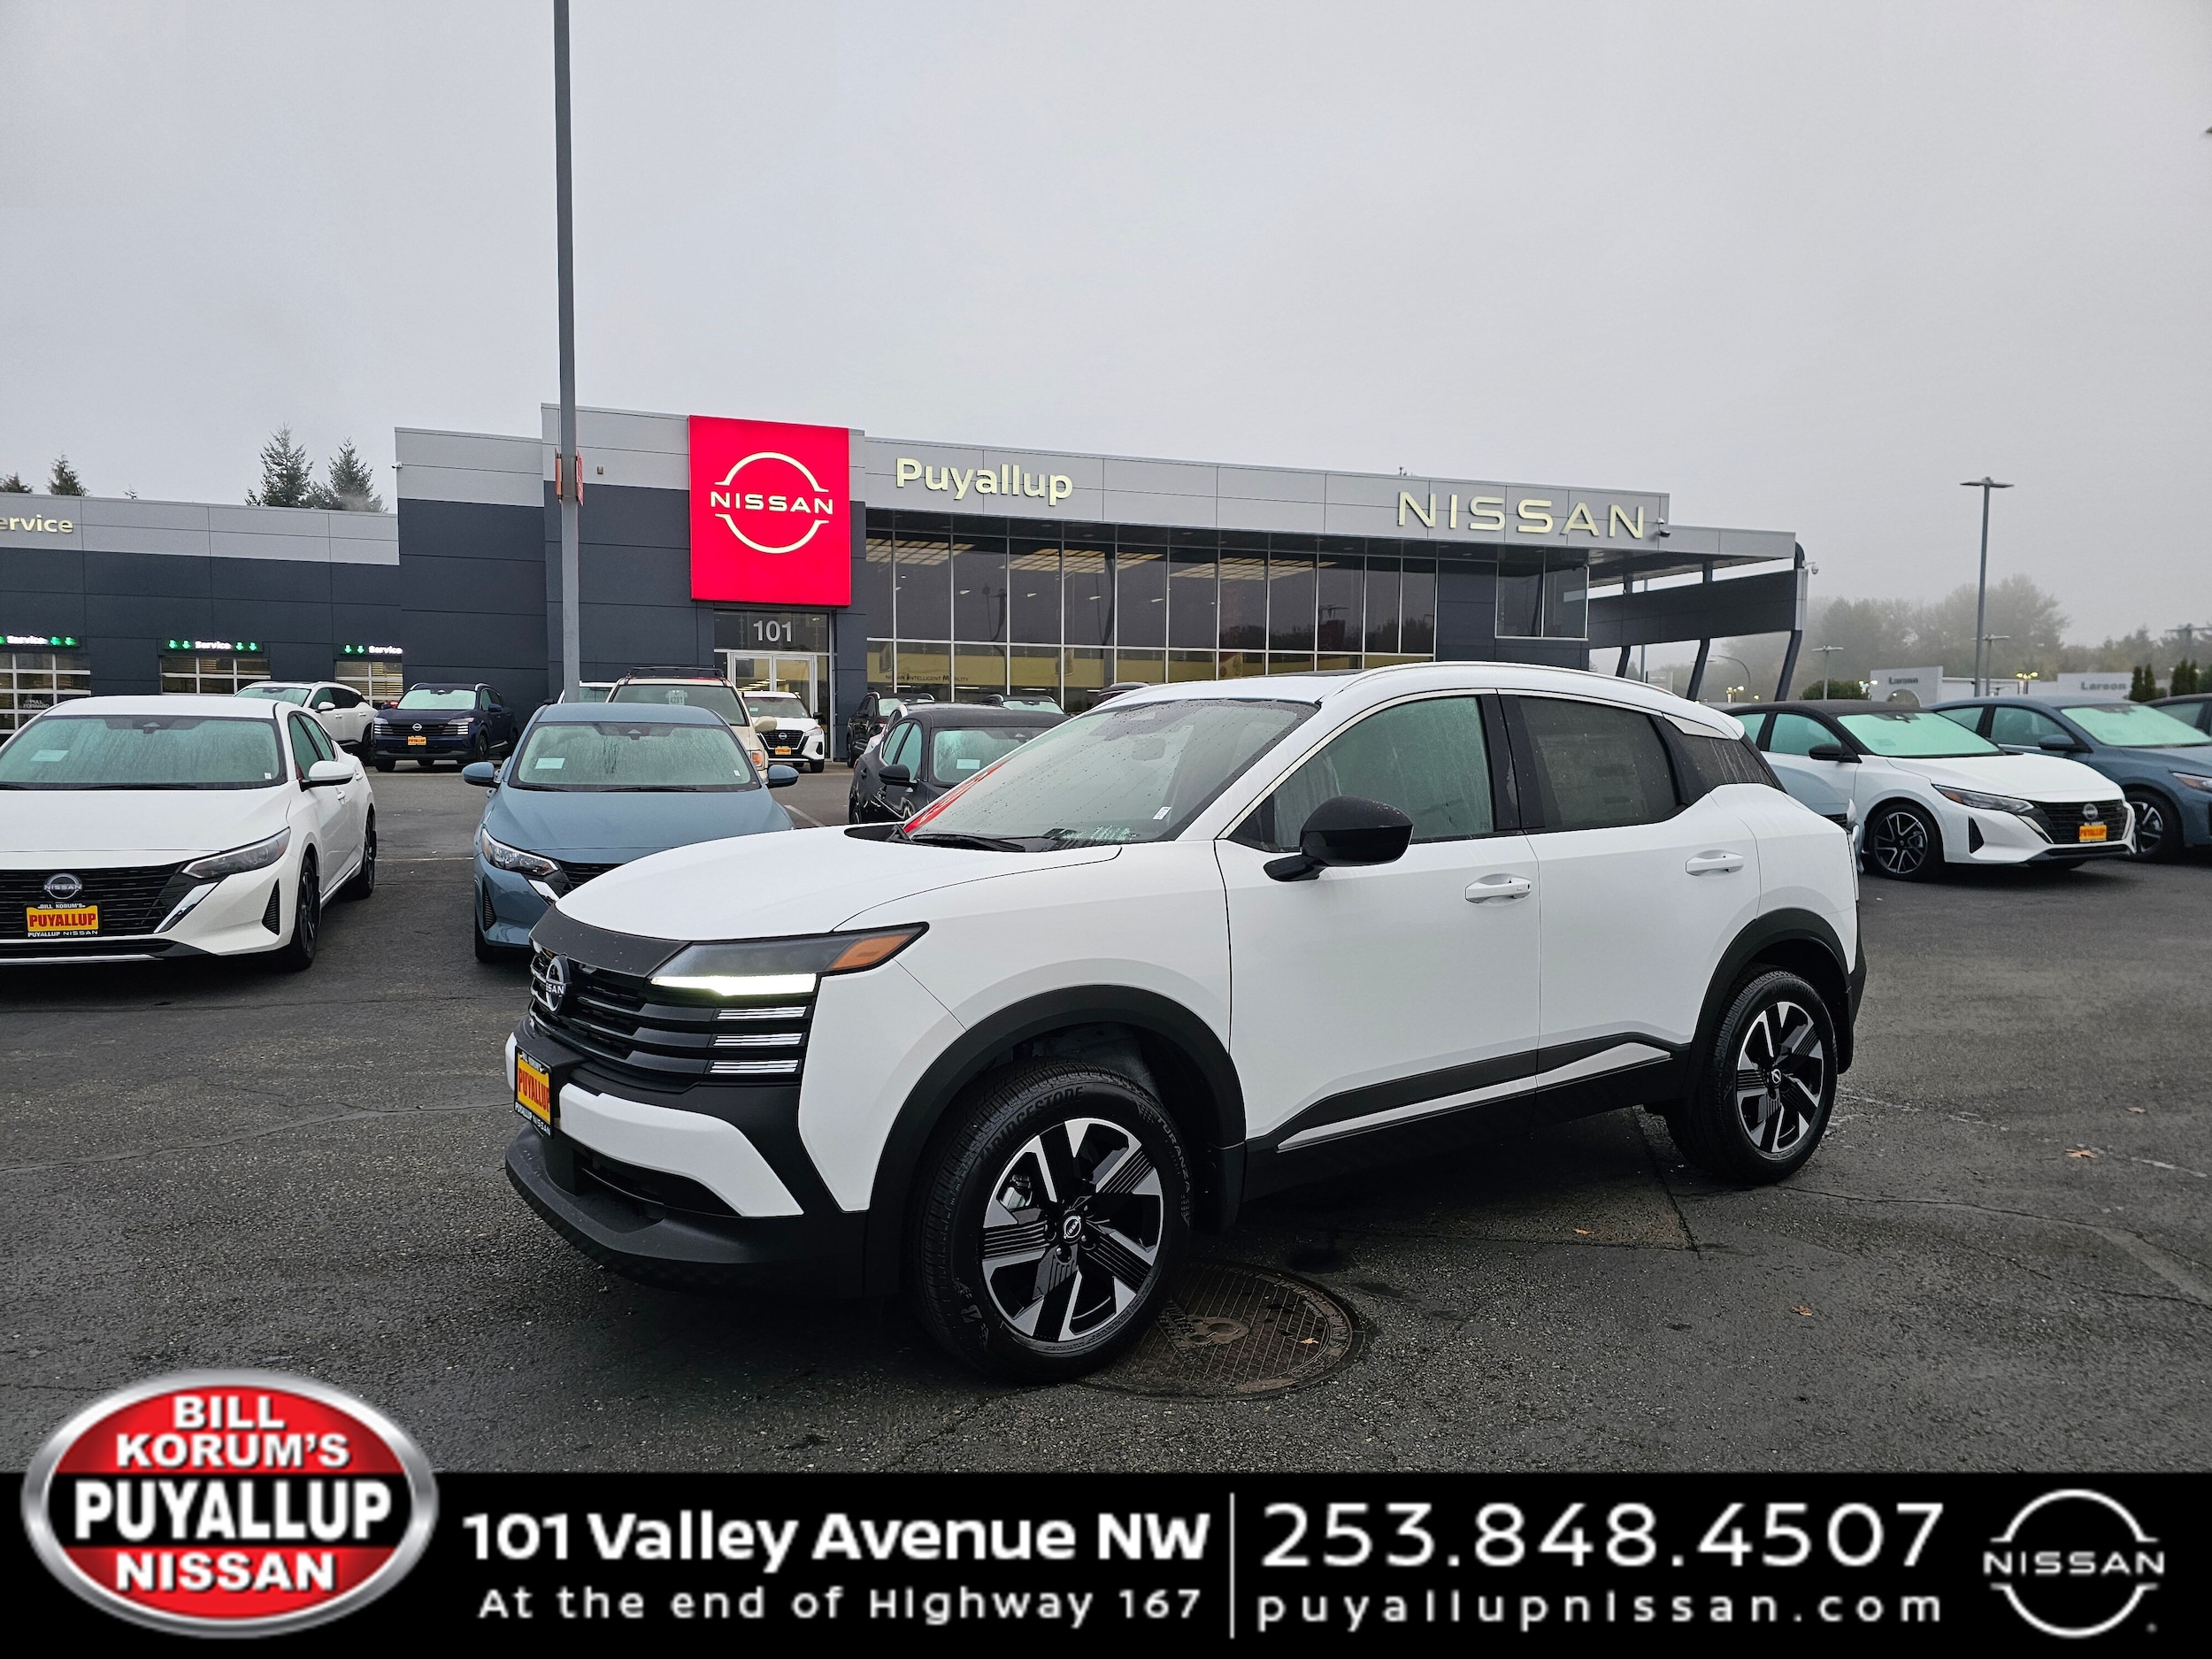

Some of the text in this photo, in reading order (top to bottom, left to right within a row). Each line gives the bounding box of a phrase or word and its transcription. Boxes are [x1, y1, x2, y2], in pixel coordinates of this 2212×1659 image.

[895, 457, 1073, 506] Puyallup
[710, 491, 833, 515] NISSAN
[1398, 491, 1644, 539] NISSAN
[753, 620, 792, 642] 101
[195, 641, 232, 649] Service
[368, 645, 403, 655] Service
[2081, 681, 2126, 690] Larson
[28, 912, 96, 927] PUYALLUP
[518, 1067, 550, 1113] PUYALLUP
[1156, 1117, 1191, 1193] TURANZA
